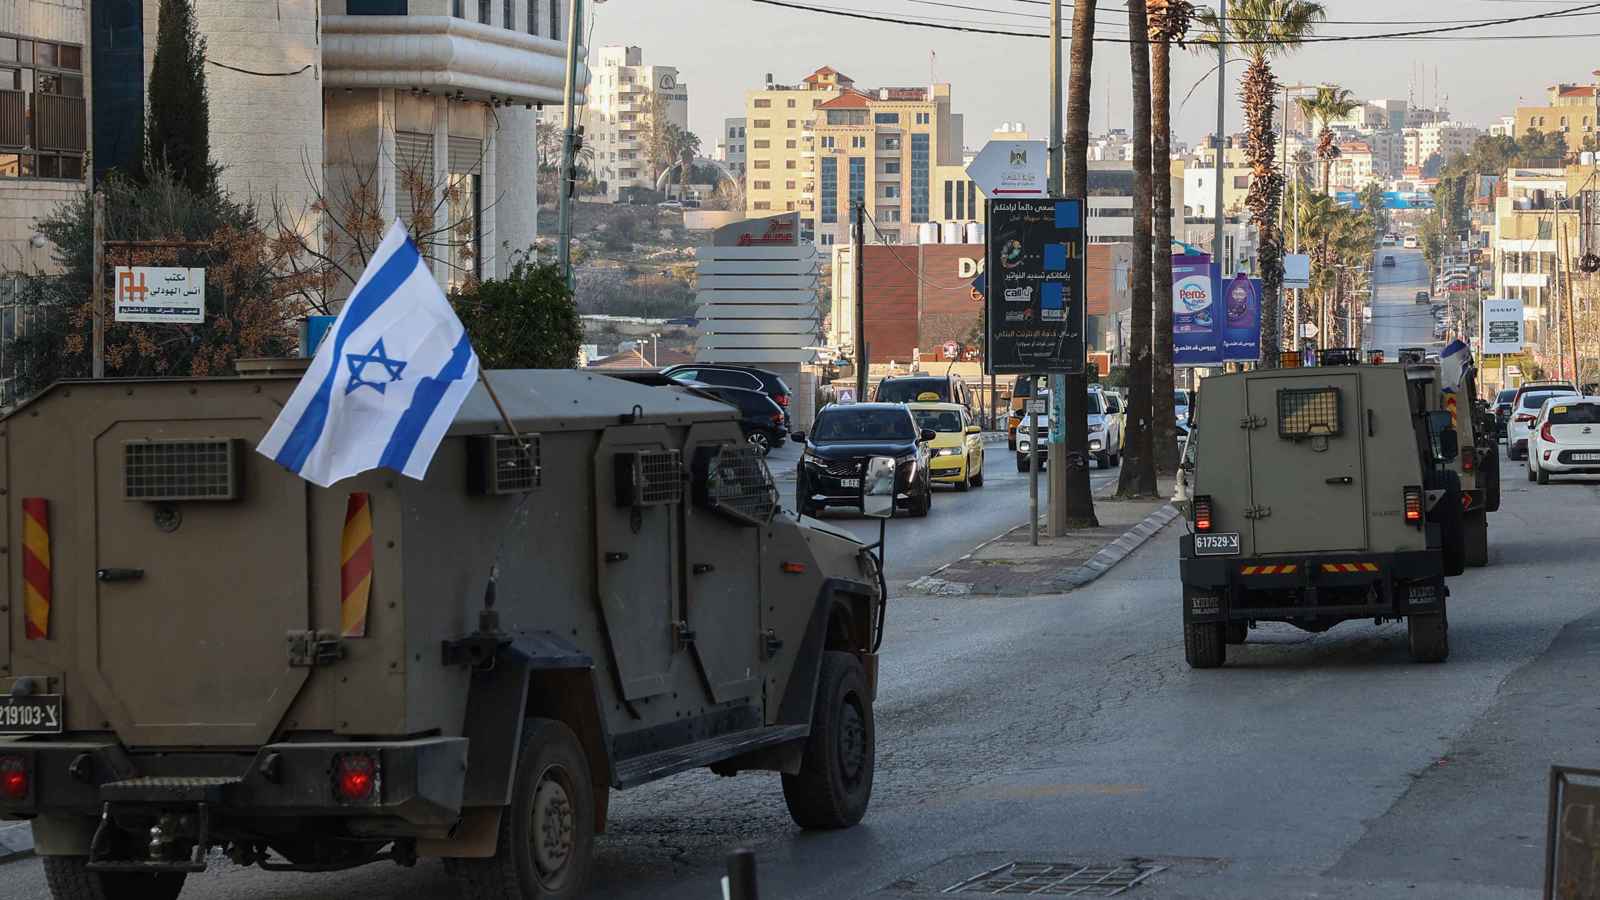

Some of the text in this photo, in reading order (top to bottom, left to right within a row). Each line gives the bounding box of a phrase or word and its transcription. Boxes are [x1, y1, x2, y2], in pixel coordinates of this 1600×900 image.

[1035, 204, 1056, 213] سعى
[164, 273, 186, 284] مكتب
[1005, 271, 1026, 281] الفواتير
